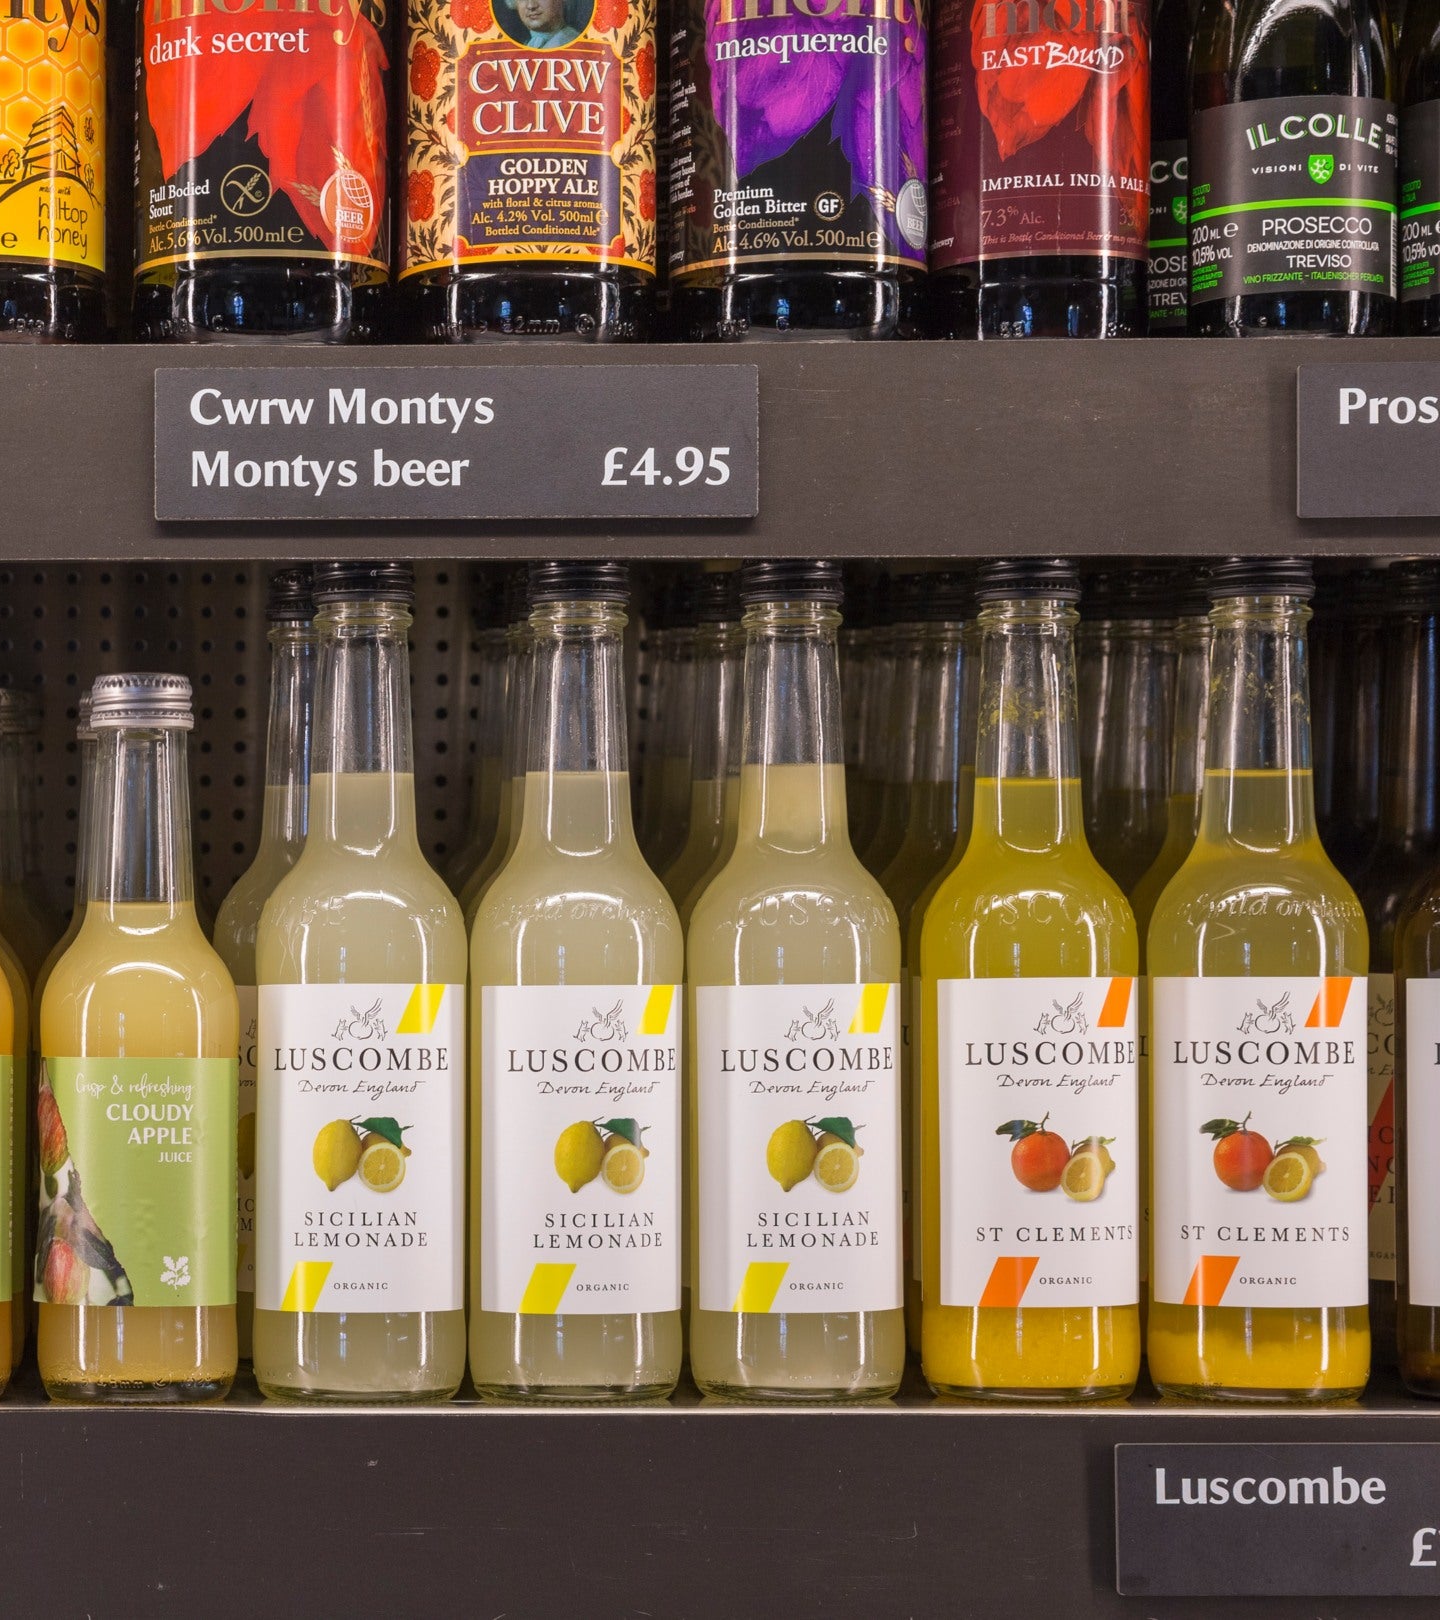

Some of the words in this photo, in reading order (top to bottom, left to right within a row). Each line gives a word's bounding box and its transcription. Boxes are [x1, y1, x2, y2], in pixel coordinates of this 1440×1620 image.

[149, 26, 203, 65] dark
[211, 28, 309, 54] secret
[715, 25, 888, 63] masquerade
[469, 58, 612, 94] CWRW
[472, 100, 607, 135] CLIVE
[1280, 112, 1382, 150] COLLE
[500, 158, 588, 176] GOLDEN
[1252, 164, 1302, 175] VISIONI
[1340, 163, 1351, 171] DI
[1357, 164, 1379, 174] VITE
[149, 188, 166, 203] Full
[168, 179, 210, 199] Bodied
[488, 179, 559, 196] HOPPY
[562, 180, 599, 196] ALE
[982, 174, 1065, 192] IMPERIAL
[1070, 173, 1116, 188] INDIA
[1120, 175, 1144, 193] PALE
[483, 199, 503, 209] with
[506, 198, 531, 208] floral
[534, 198, 544, 207] &
[546, 198, 571, 208] citrus
[713, 186, 774, 204] Premium
[149, 205, 173, 220] Stout
[713, 202, 761, 220] Golden
[766, 200, 807, 214] Bitter
[817, 199, 839, 212] GF
[336, 210, 364, 224] BEER
[472, 211, 493, 225] Alc.
[497, 210, 528, 222] 4.2%
[532, 210, 555, 222] Vol.
[559, 210, 594, 223] 500ml
[906, 218, 924, 232] BEER
[982, 206, 1019, 228] 7.3%
[1020, 210, 1045, 225] Alc.
[1262, 216, 1372, 236] PROSECCO
[38, 221, 87, 259] honey
[1217, 248, 1233, 259] VOL
[1286, 254, 1352, 268] TREVISO
[1243, 273, 1262, 284] VINO
[1262, 272, 1303, 282] FRIZZANTE
[190, 388, 315, 425] Cwrw
[328, 388, 494, 433] Montys
[1340, 388, 1439, 424] Pros
[191, 451, 358, 496] Montys
[373, 448, 469, 487] beer
[601, 446, 730, 486] £4.95
[274, 1047, 448, 1071] LUSCOMBE
[507, 1048, 676, 1073] LUSCOMBE
[721, 1046, 893, 1073] LUSCOMBE
[965, 1041, 1135, 1065] LUSCOMBE
[297, 1079, 350, 1095] Devon
[354, 1079, 426, 1101] England
[537, 1080, 591, 1096] Devon
[596, 1080, 660, 1101] England
[106, 1104, 194, 1122] CLOUDY
[127, 1127, 192, 1145] APPLE
[304, 1211, 418, 1227] SICILIAN
[544, 1212, 655, 1228] SICILIAN
[758, 1211, 871, 1227] SICILIAN
[294, 1232, 428, 1248] LEMONADE
[533, 1233, 663, 1249] LEMONADE
[746, 1232, 879, 1248] LEMONADE
[976, 1227, 1003, 1242] ST
[1016, 1225, 1133, 1242] CLEMENTS
[1180, 1225, 1205, 1241] ST
[1217, 1225, 1350, 1242] CLEMENTS
[333, 1281, 389, 1291] ORGANIC
[576, 1283, 631, 1292] ORGANIC
[789, 1282, 844, 1291] ORGANIC
[1156, 1466, 1386, 1504] Luscombe
